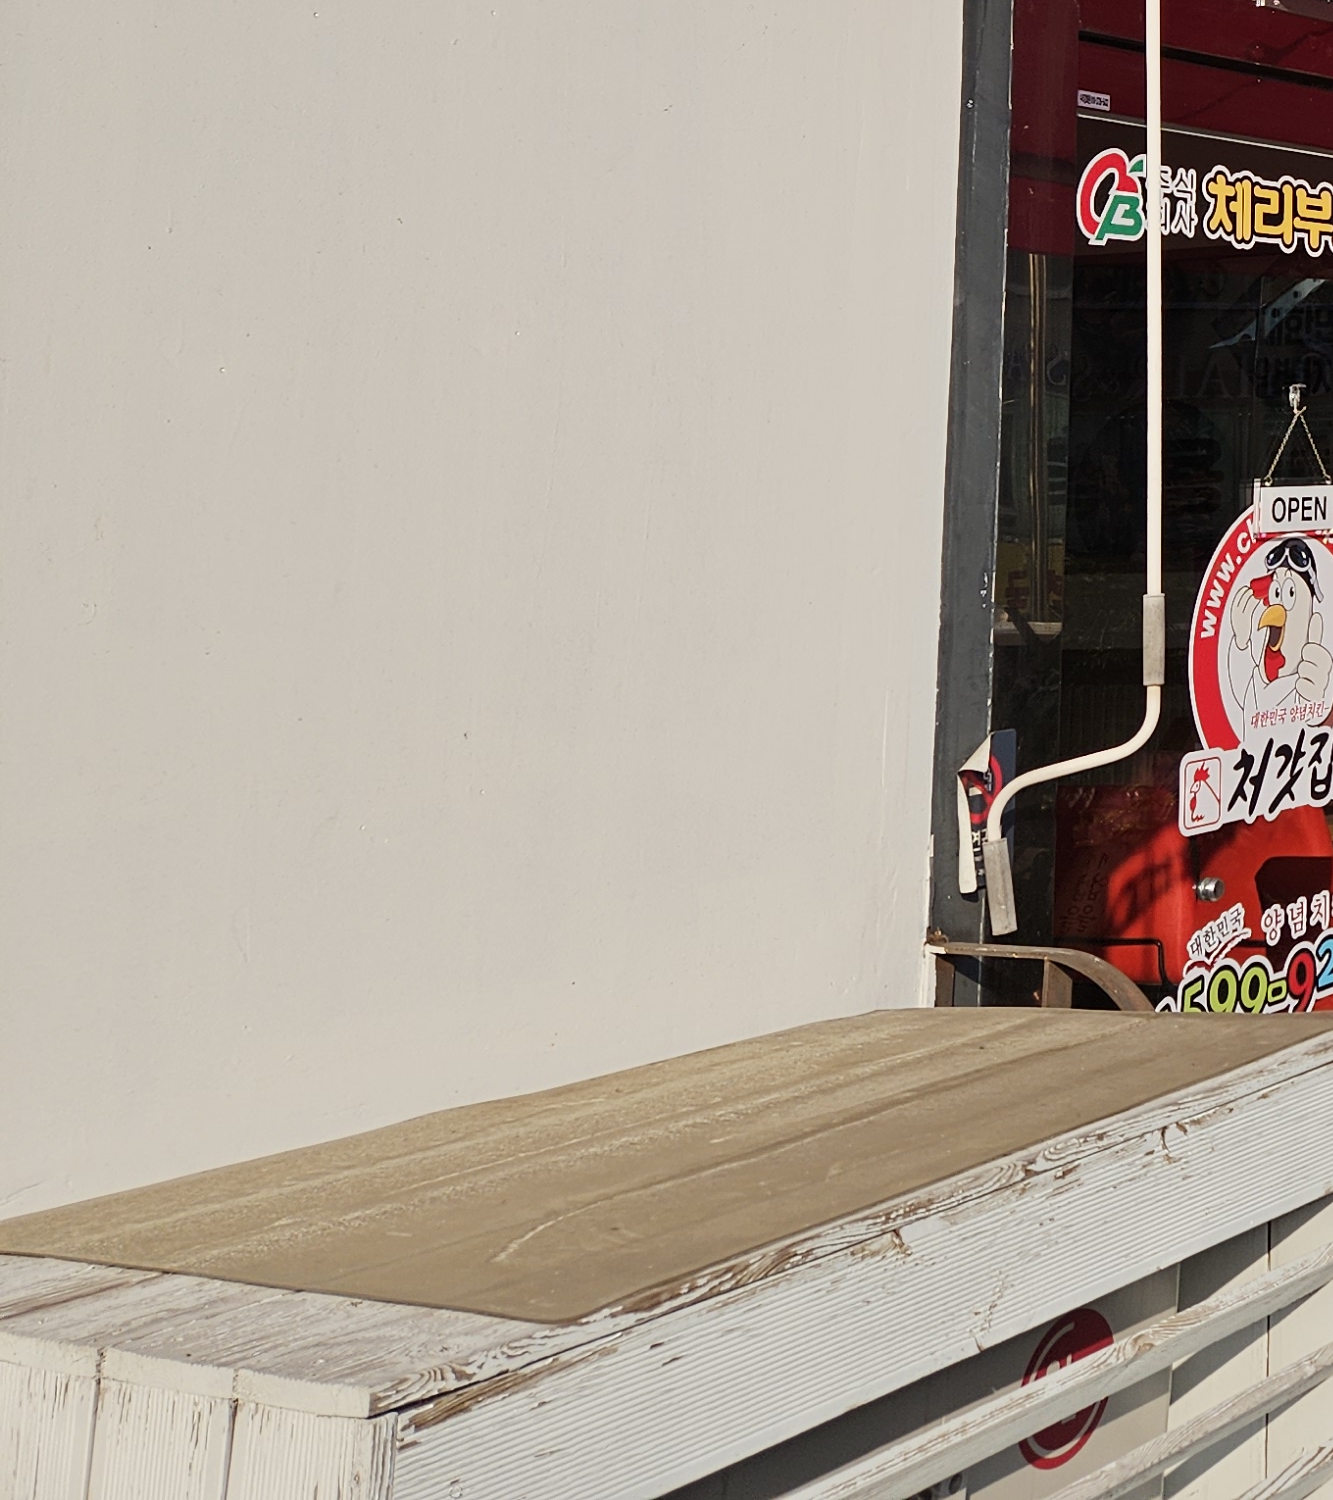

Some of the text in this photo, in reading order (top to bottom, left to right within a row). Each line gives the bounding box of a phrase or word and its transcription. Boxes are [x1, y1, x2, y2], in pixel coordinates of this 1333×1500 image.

[1271, 496, 1328, 523] OPEN
[1250, 706, 1288, 729] 대한민국
[1187, 903, 1248, 961] 대한민국
